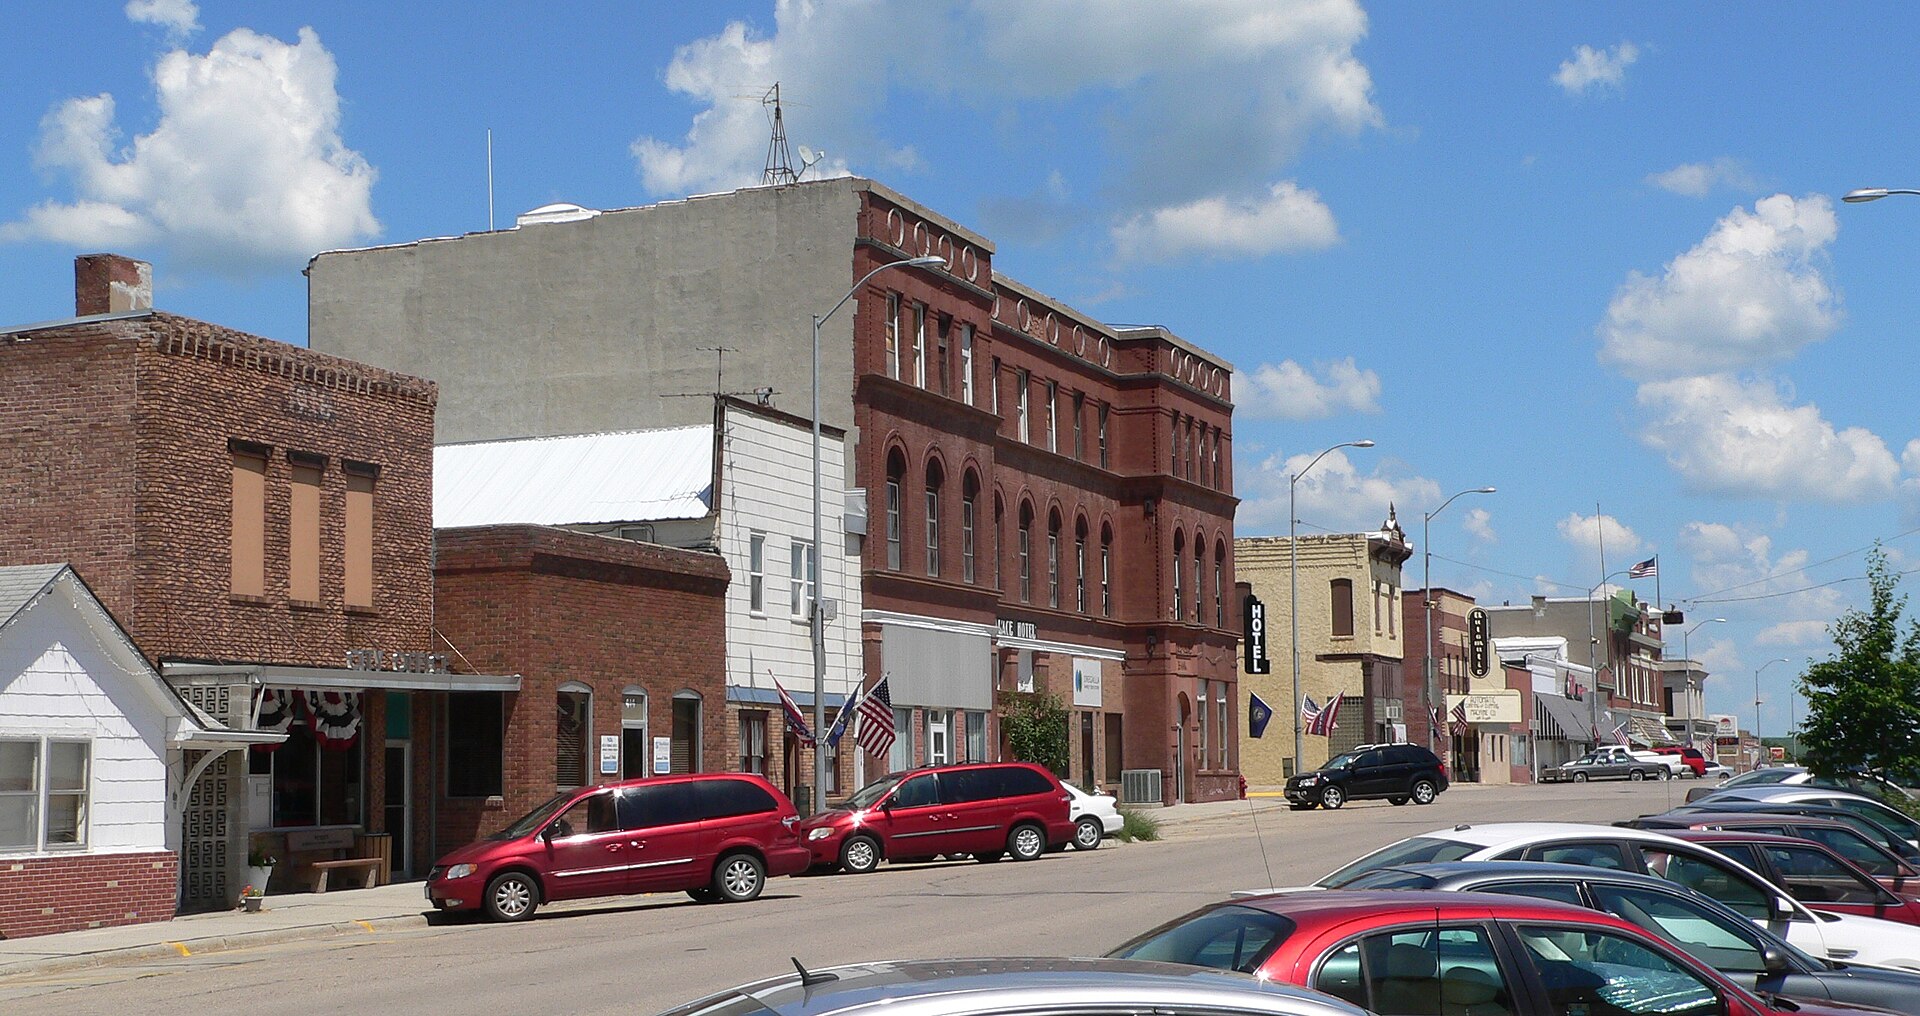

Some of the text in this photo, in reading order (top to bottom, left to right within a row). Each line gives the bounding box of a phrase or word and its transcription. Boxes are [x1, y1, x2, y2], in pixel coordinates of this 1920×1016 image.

[1017, 622, 1037, 640] HOTEL
[1251, 604, 1262, 673] HOTEL
[1473, 611, 1484, 675] Automatic
